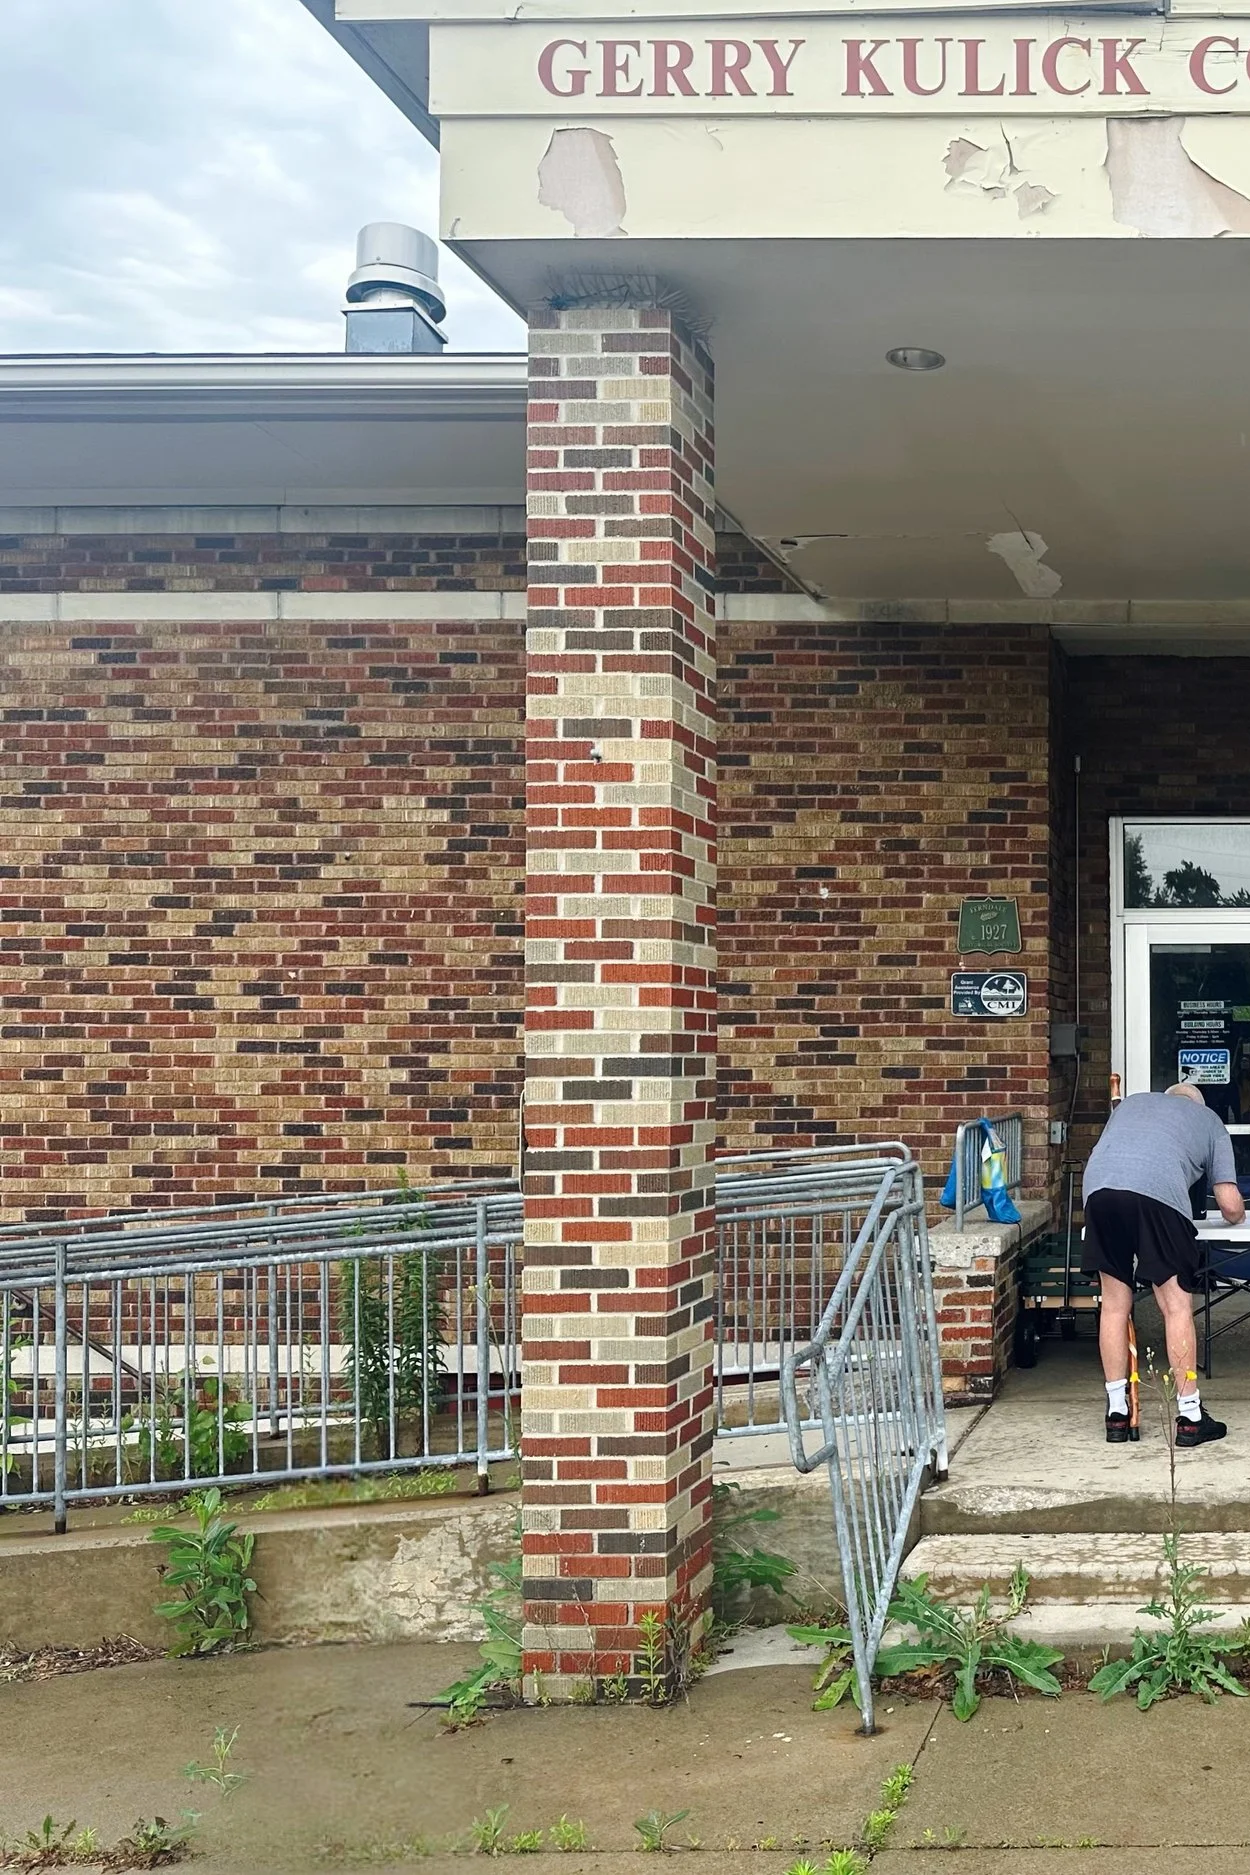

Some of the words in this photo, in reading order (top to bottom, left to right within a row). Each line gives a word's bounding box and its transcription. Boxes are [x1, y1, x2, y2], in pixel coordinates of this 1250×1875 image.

[537, 38, 806, 98] GERRY
[841, 37, 1150, 97] KULICK
[981, 924, 1008, 941] 1927
[987, 1001, 1016, 1009] CMI
[1181, 1053, 1227, 1063] NOTICE
